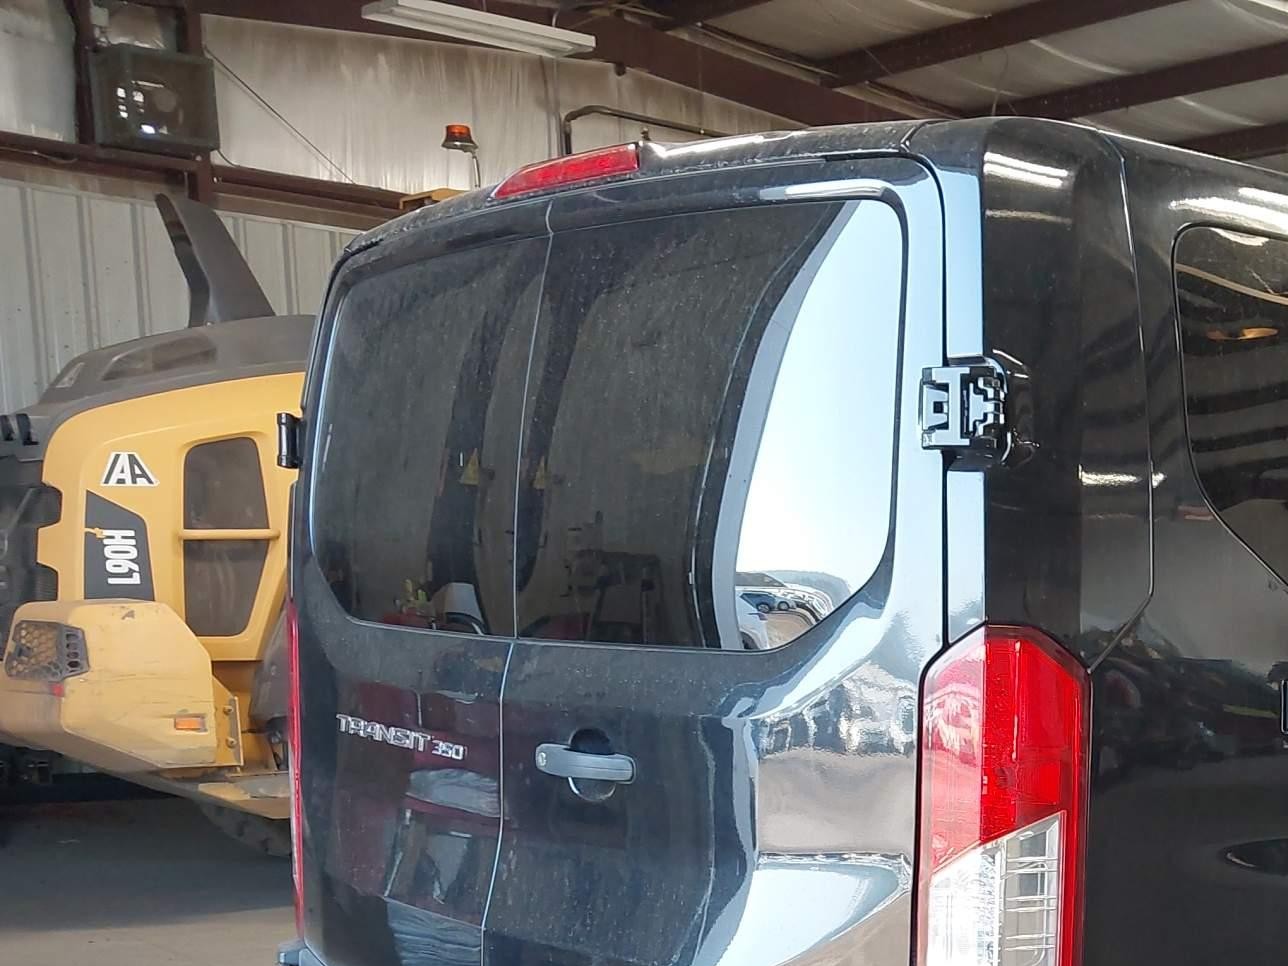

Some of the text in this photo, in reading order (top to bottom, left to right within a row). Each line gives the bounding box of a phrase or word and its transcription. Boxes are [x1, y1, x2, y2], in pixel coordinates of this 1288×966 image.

[103, 529, 141, 585] L90H
[336, 713, 465, 760] TRANSIT 350
